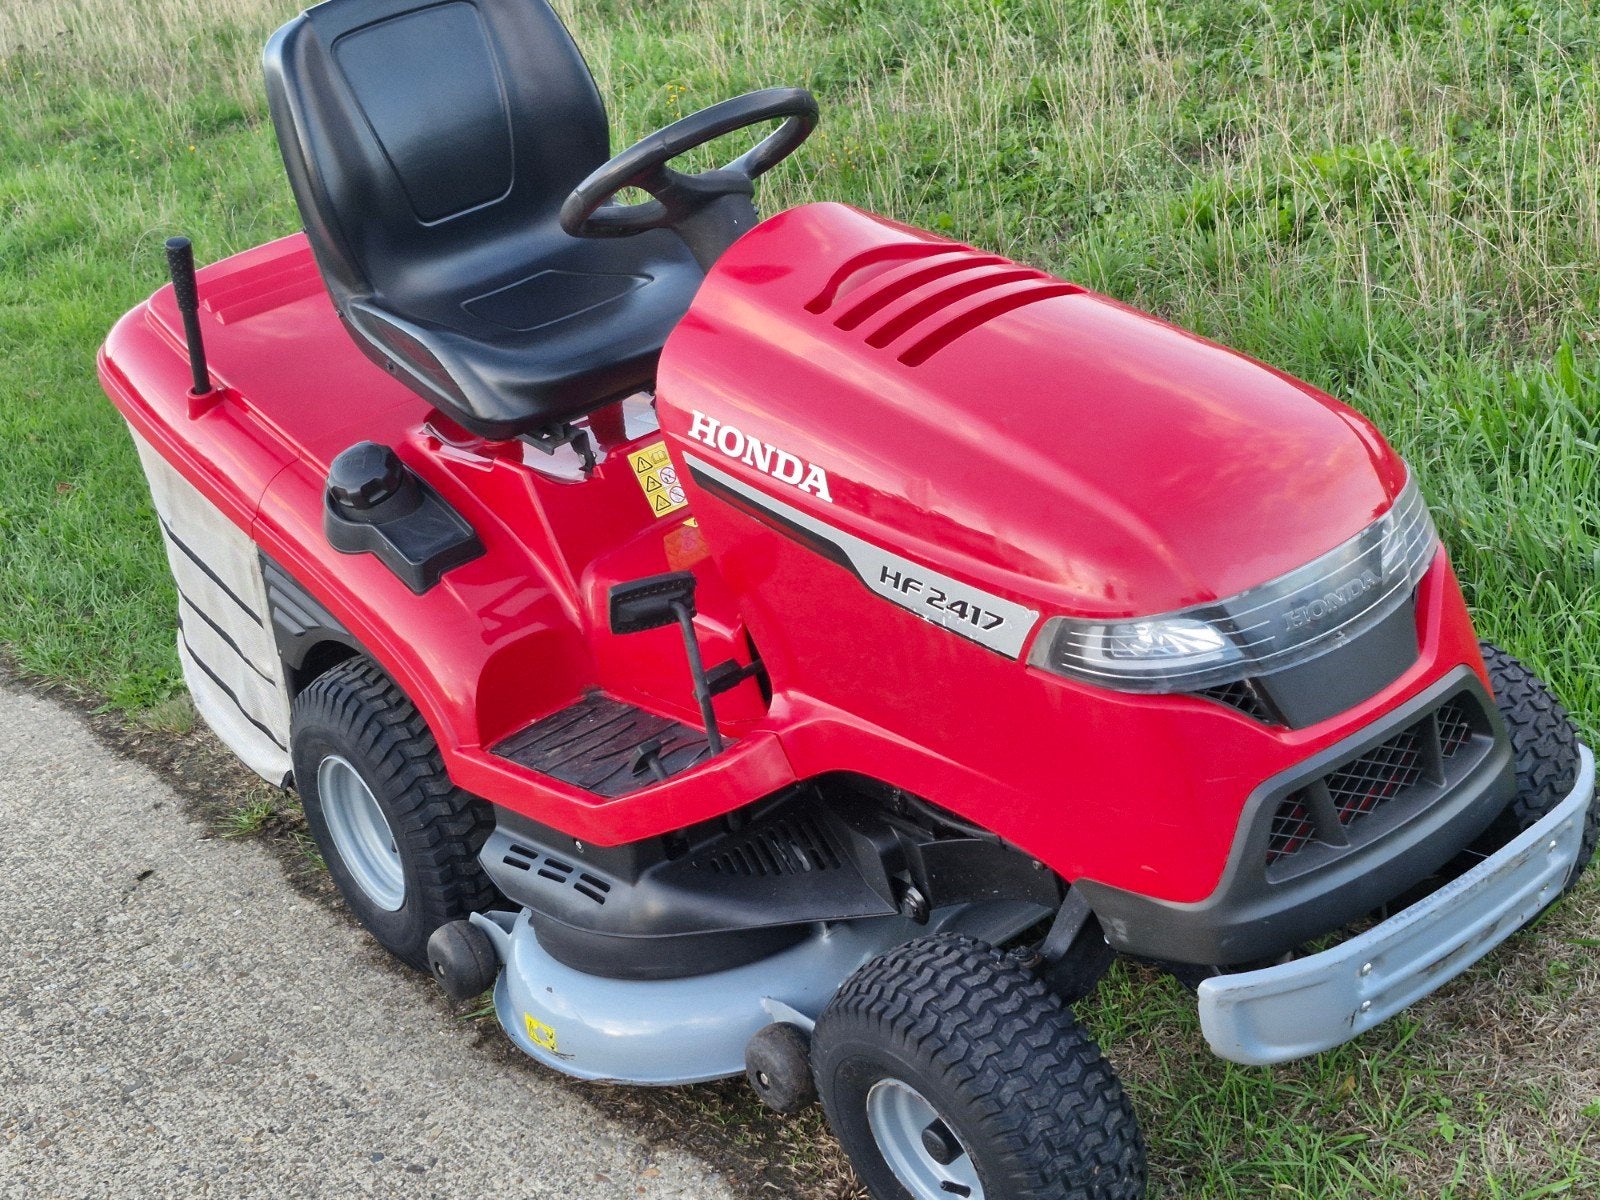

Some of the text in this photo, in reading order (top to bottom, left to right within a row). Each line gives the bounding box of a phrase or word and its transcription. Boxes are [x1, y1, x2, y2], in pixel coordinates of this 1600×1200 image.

[688, 409, 833, 503] HONDA
[880, 565, 1005, 631] HF 2417
[1282, 569, 1382, 631] HONDA
